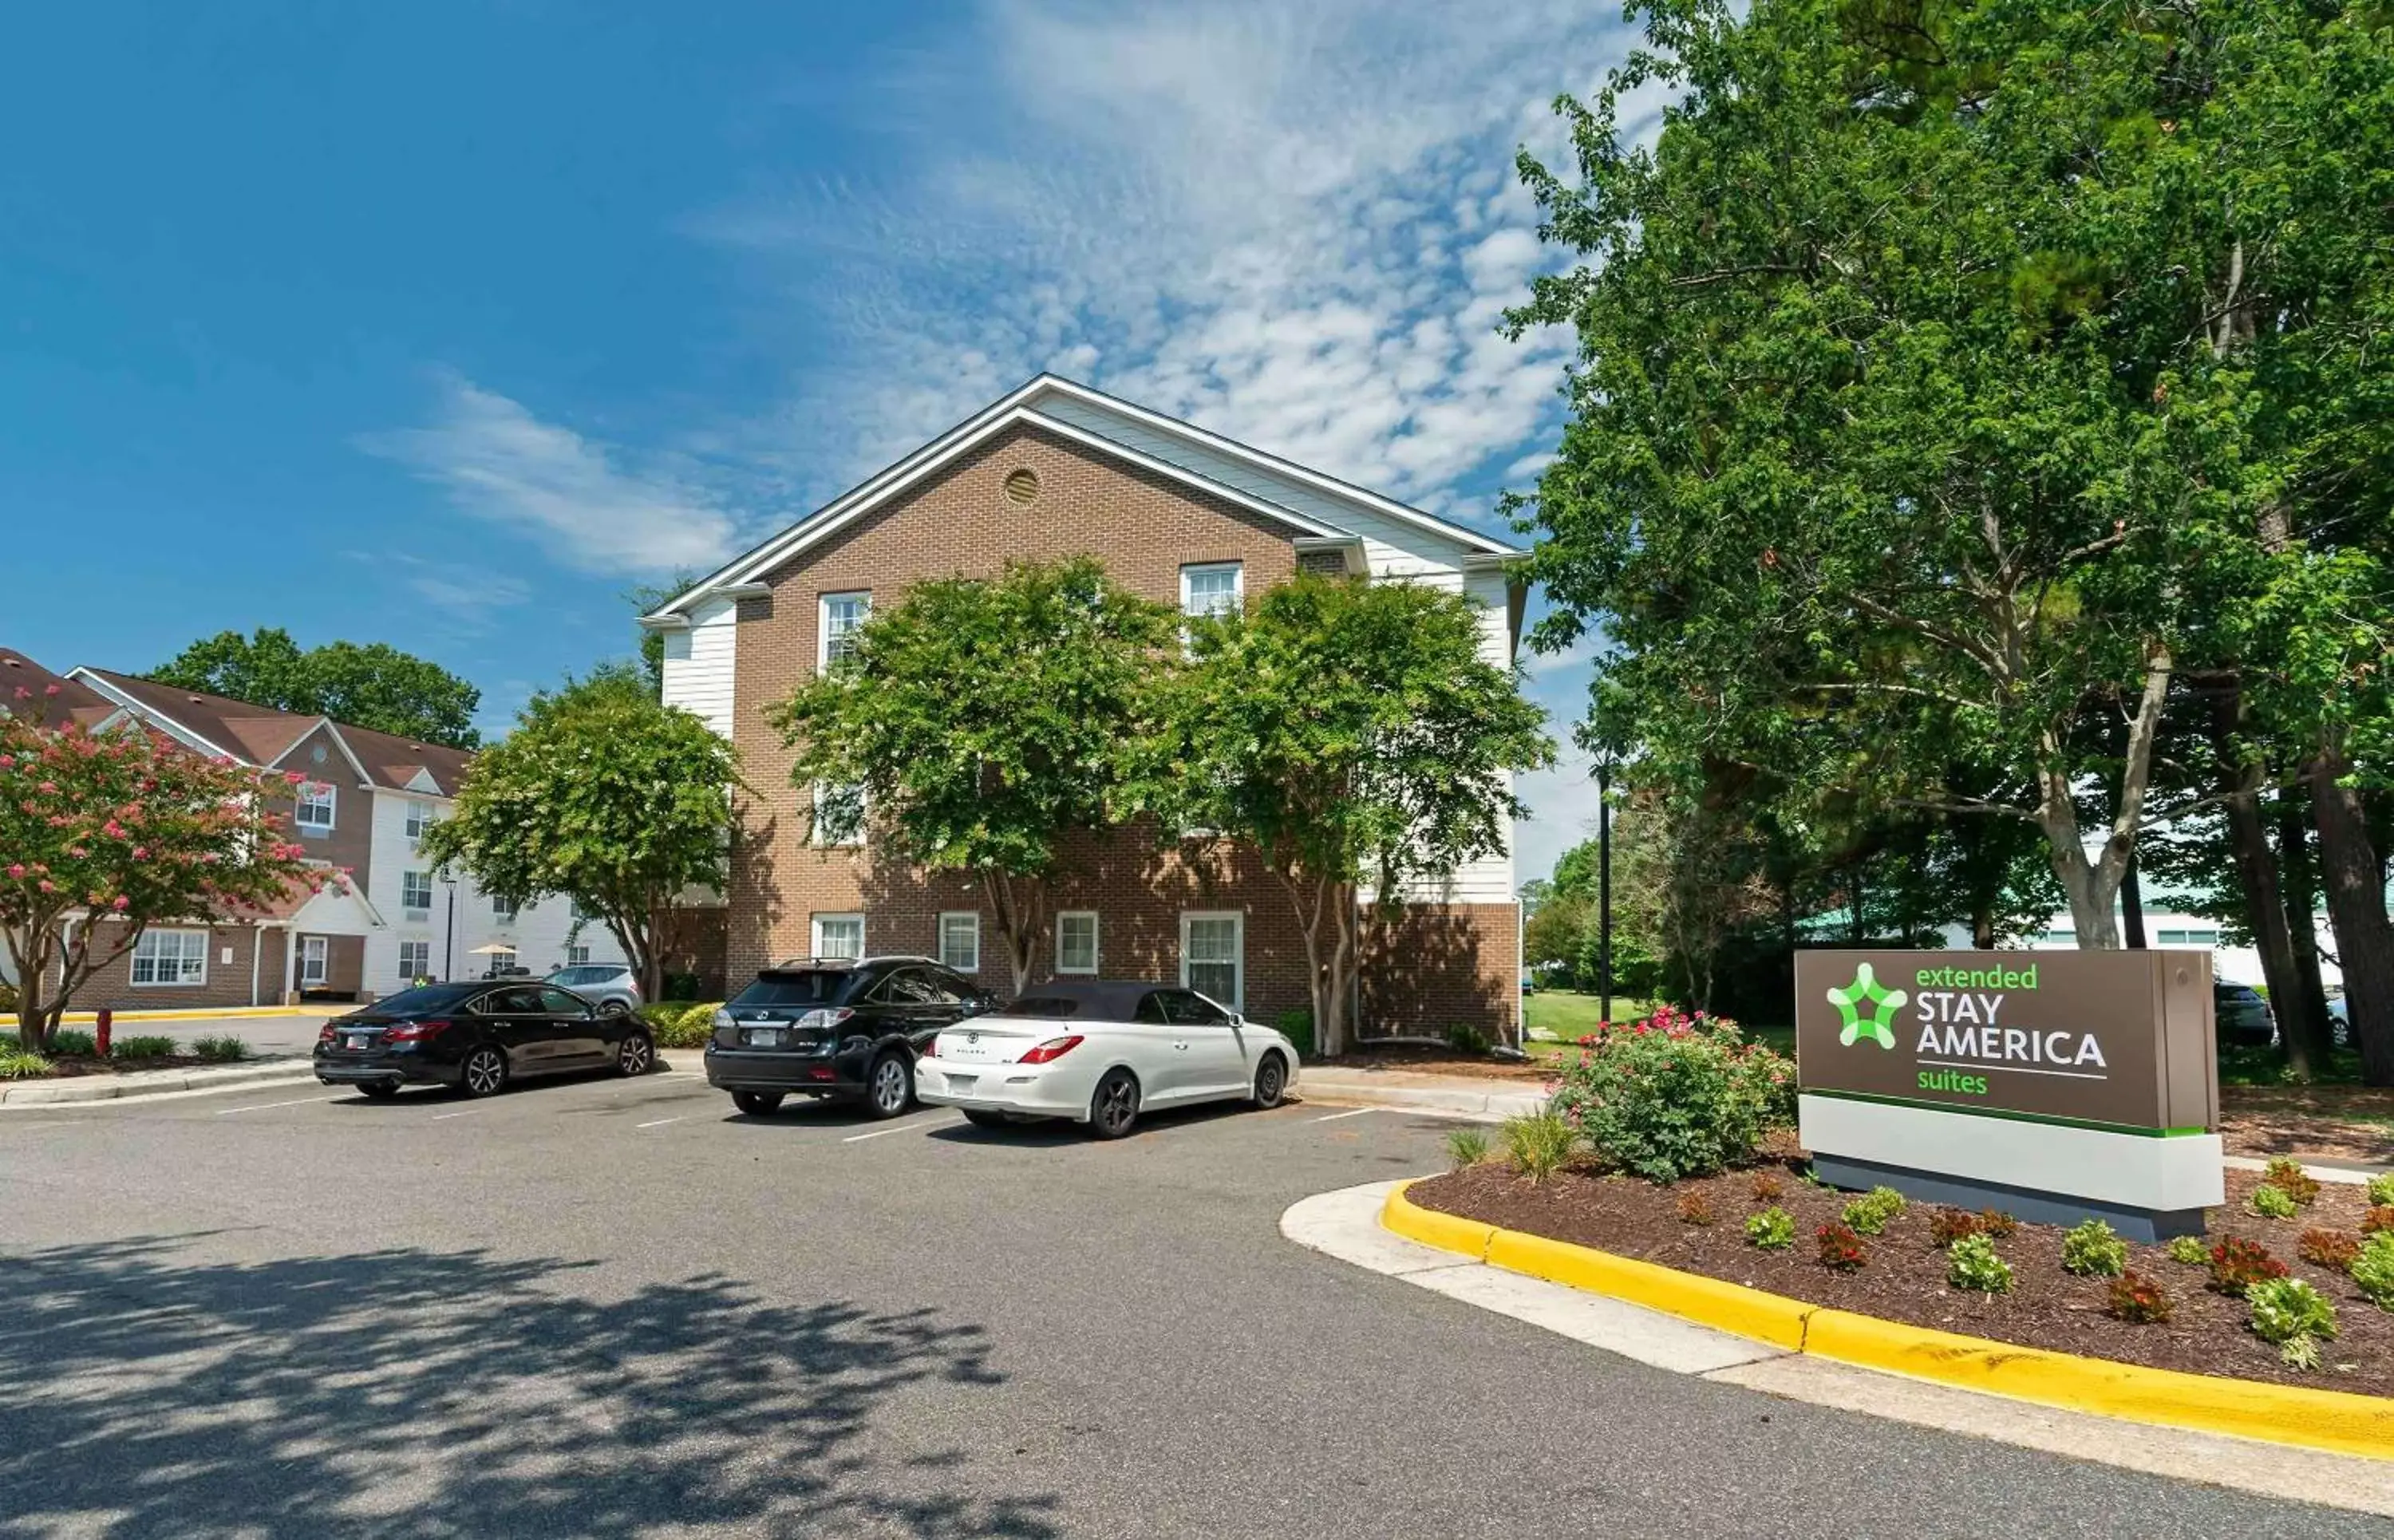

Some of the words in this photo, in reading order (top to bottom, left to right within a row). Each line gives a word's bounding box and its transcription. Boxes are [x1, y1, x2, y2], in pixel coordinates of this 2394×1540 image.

[1916, 964, 2037, 989] extended
[1917, 992, 2004, 1024] STAY
[1916, 1025, 2107, 1067] AMERICA
[1918, 1069, 1987, 1094] suites
